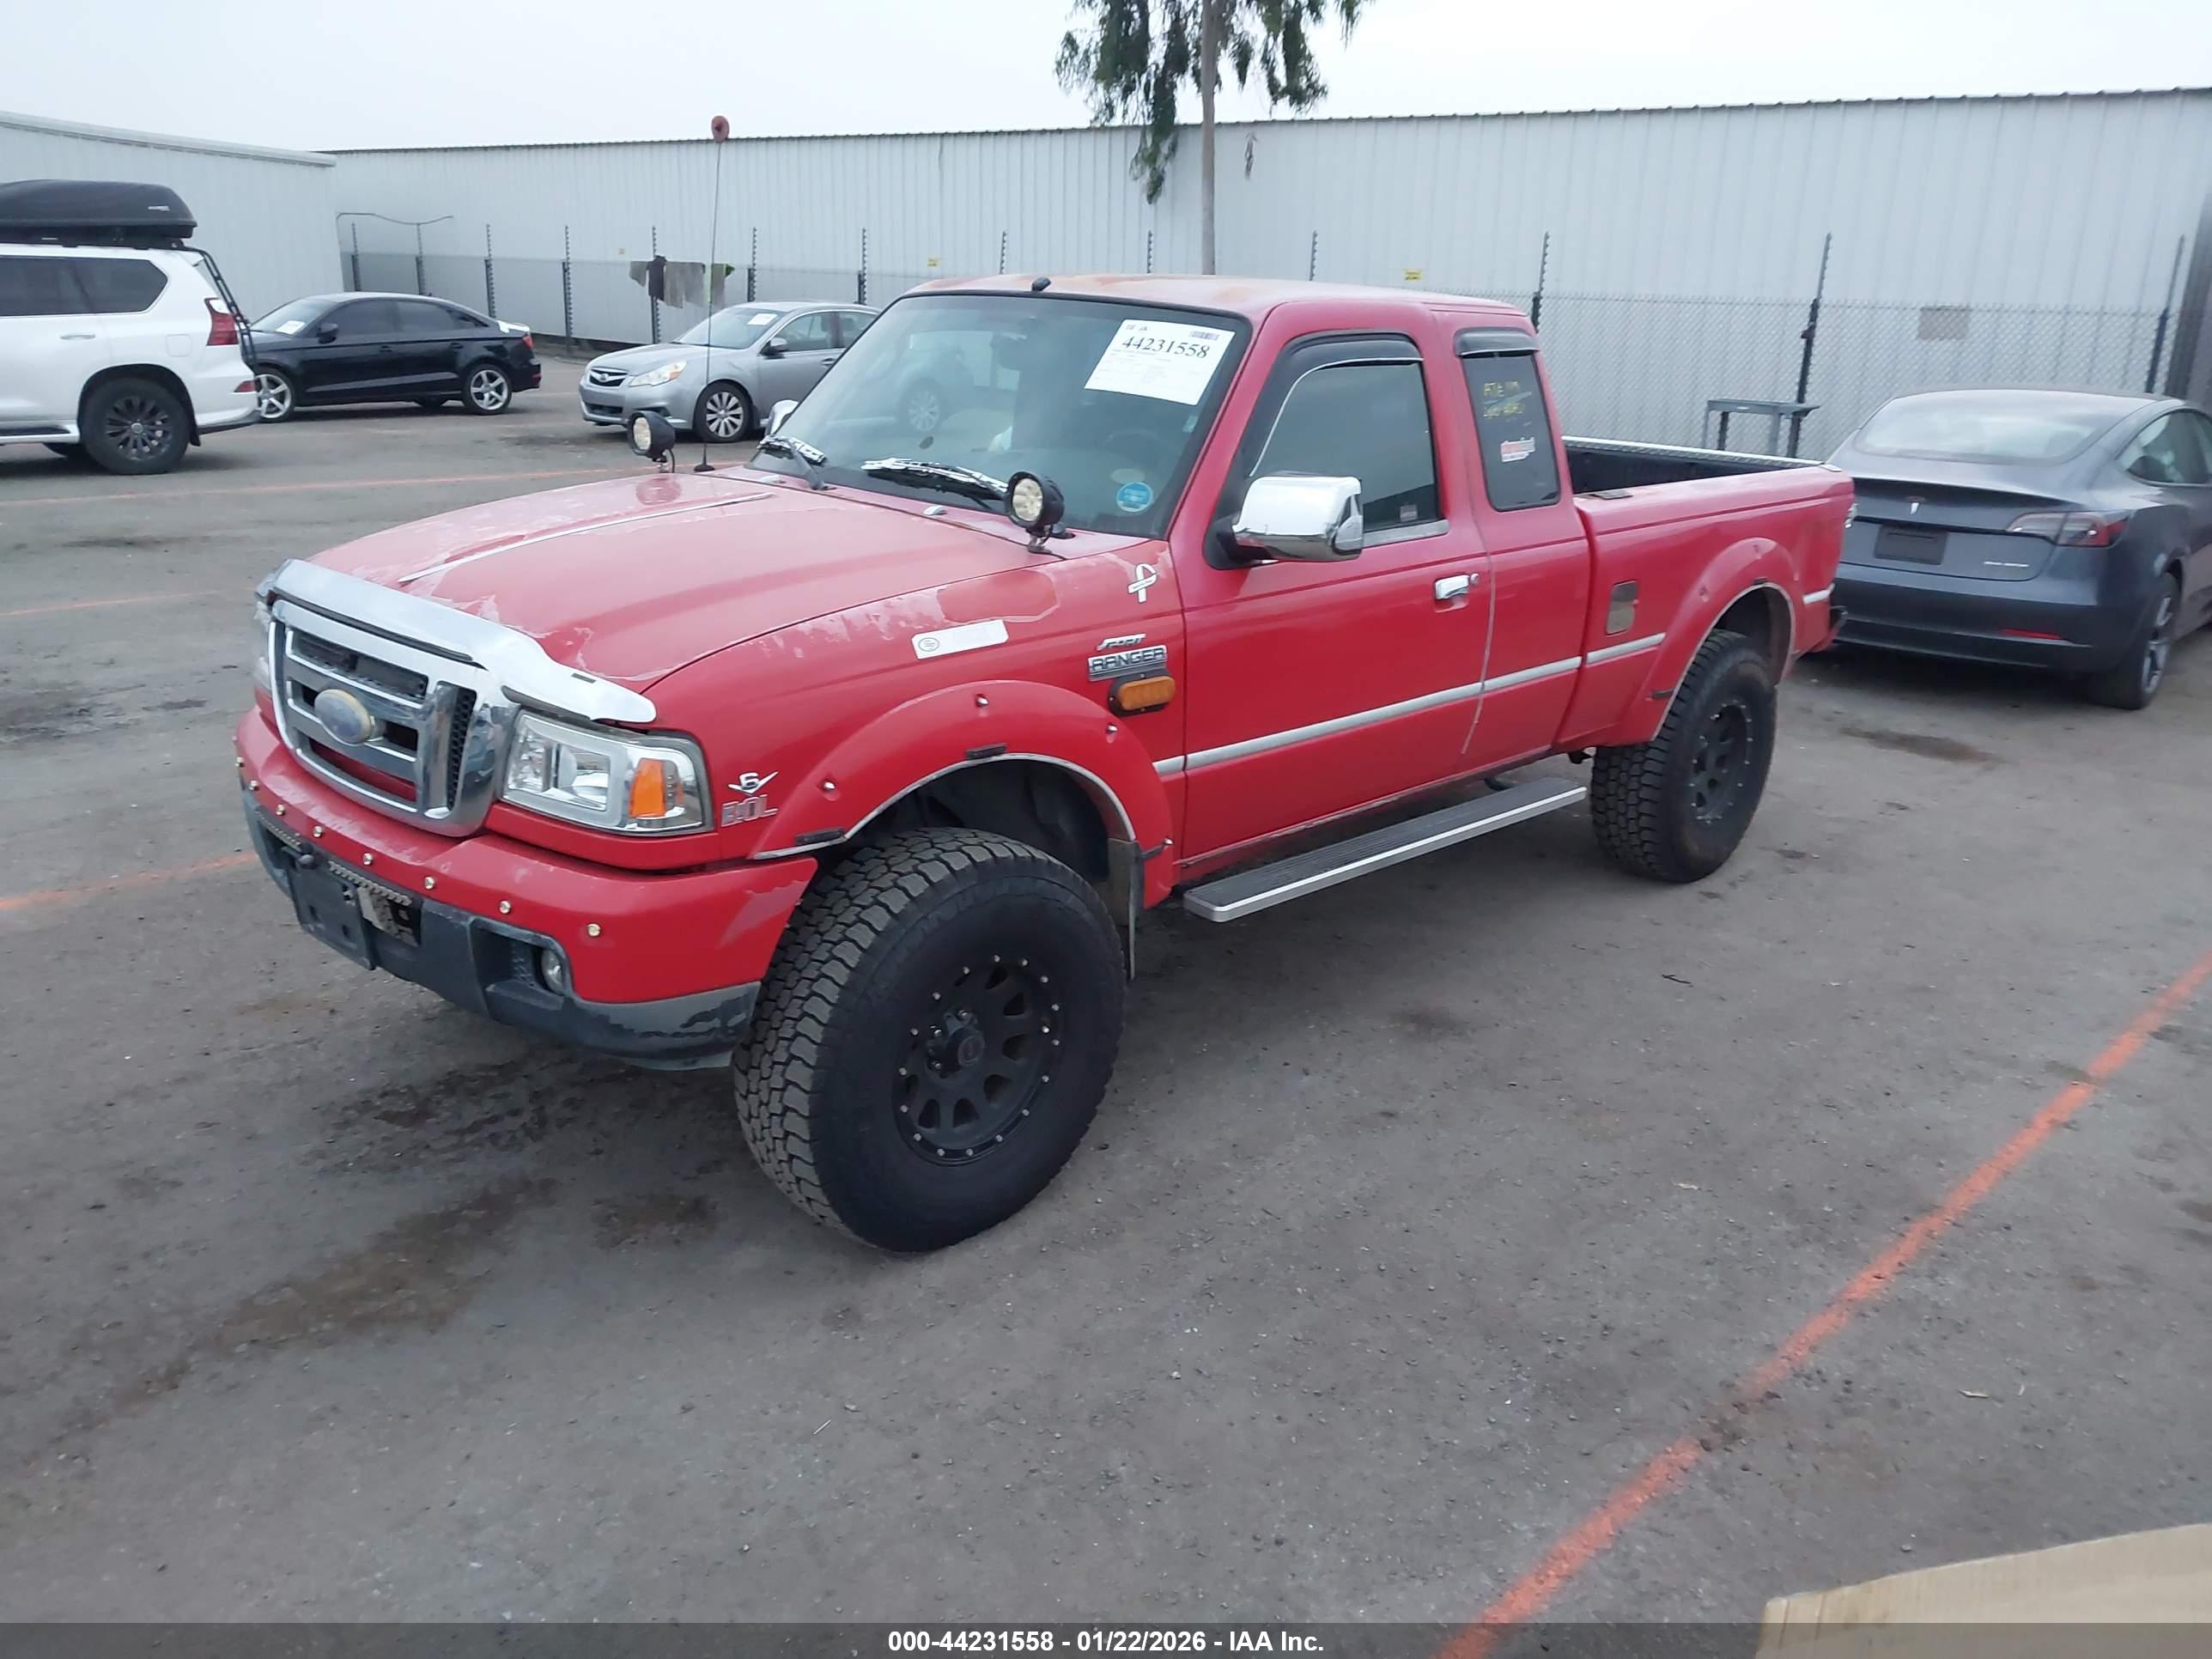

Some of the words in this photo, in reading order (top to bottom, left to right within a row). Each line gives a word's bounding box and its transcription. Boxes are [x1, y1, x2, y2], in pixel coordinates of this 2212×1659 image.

[1122, 336, 1210, 359] 44231558
[1097, 633, 1147, 652] SPORT
[1091, 647, 1165, 672] RANGER
